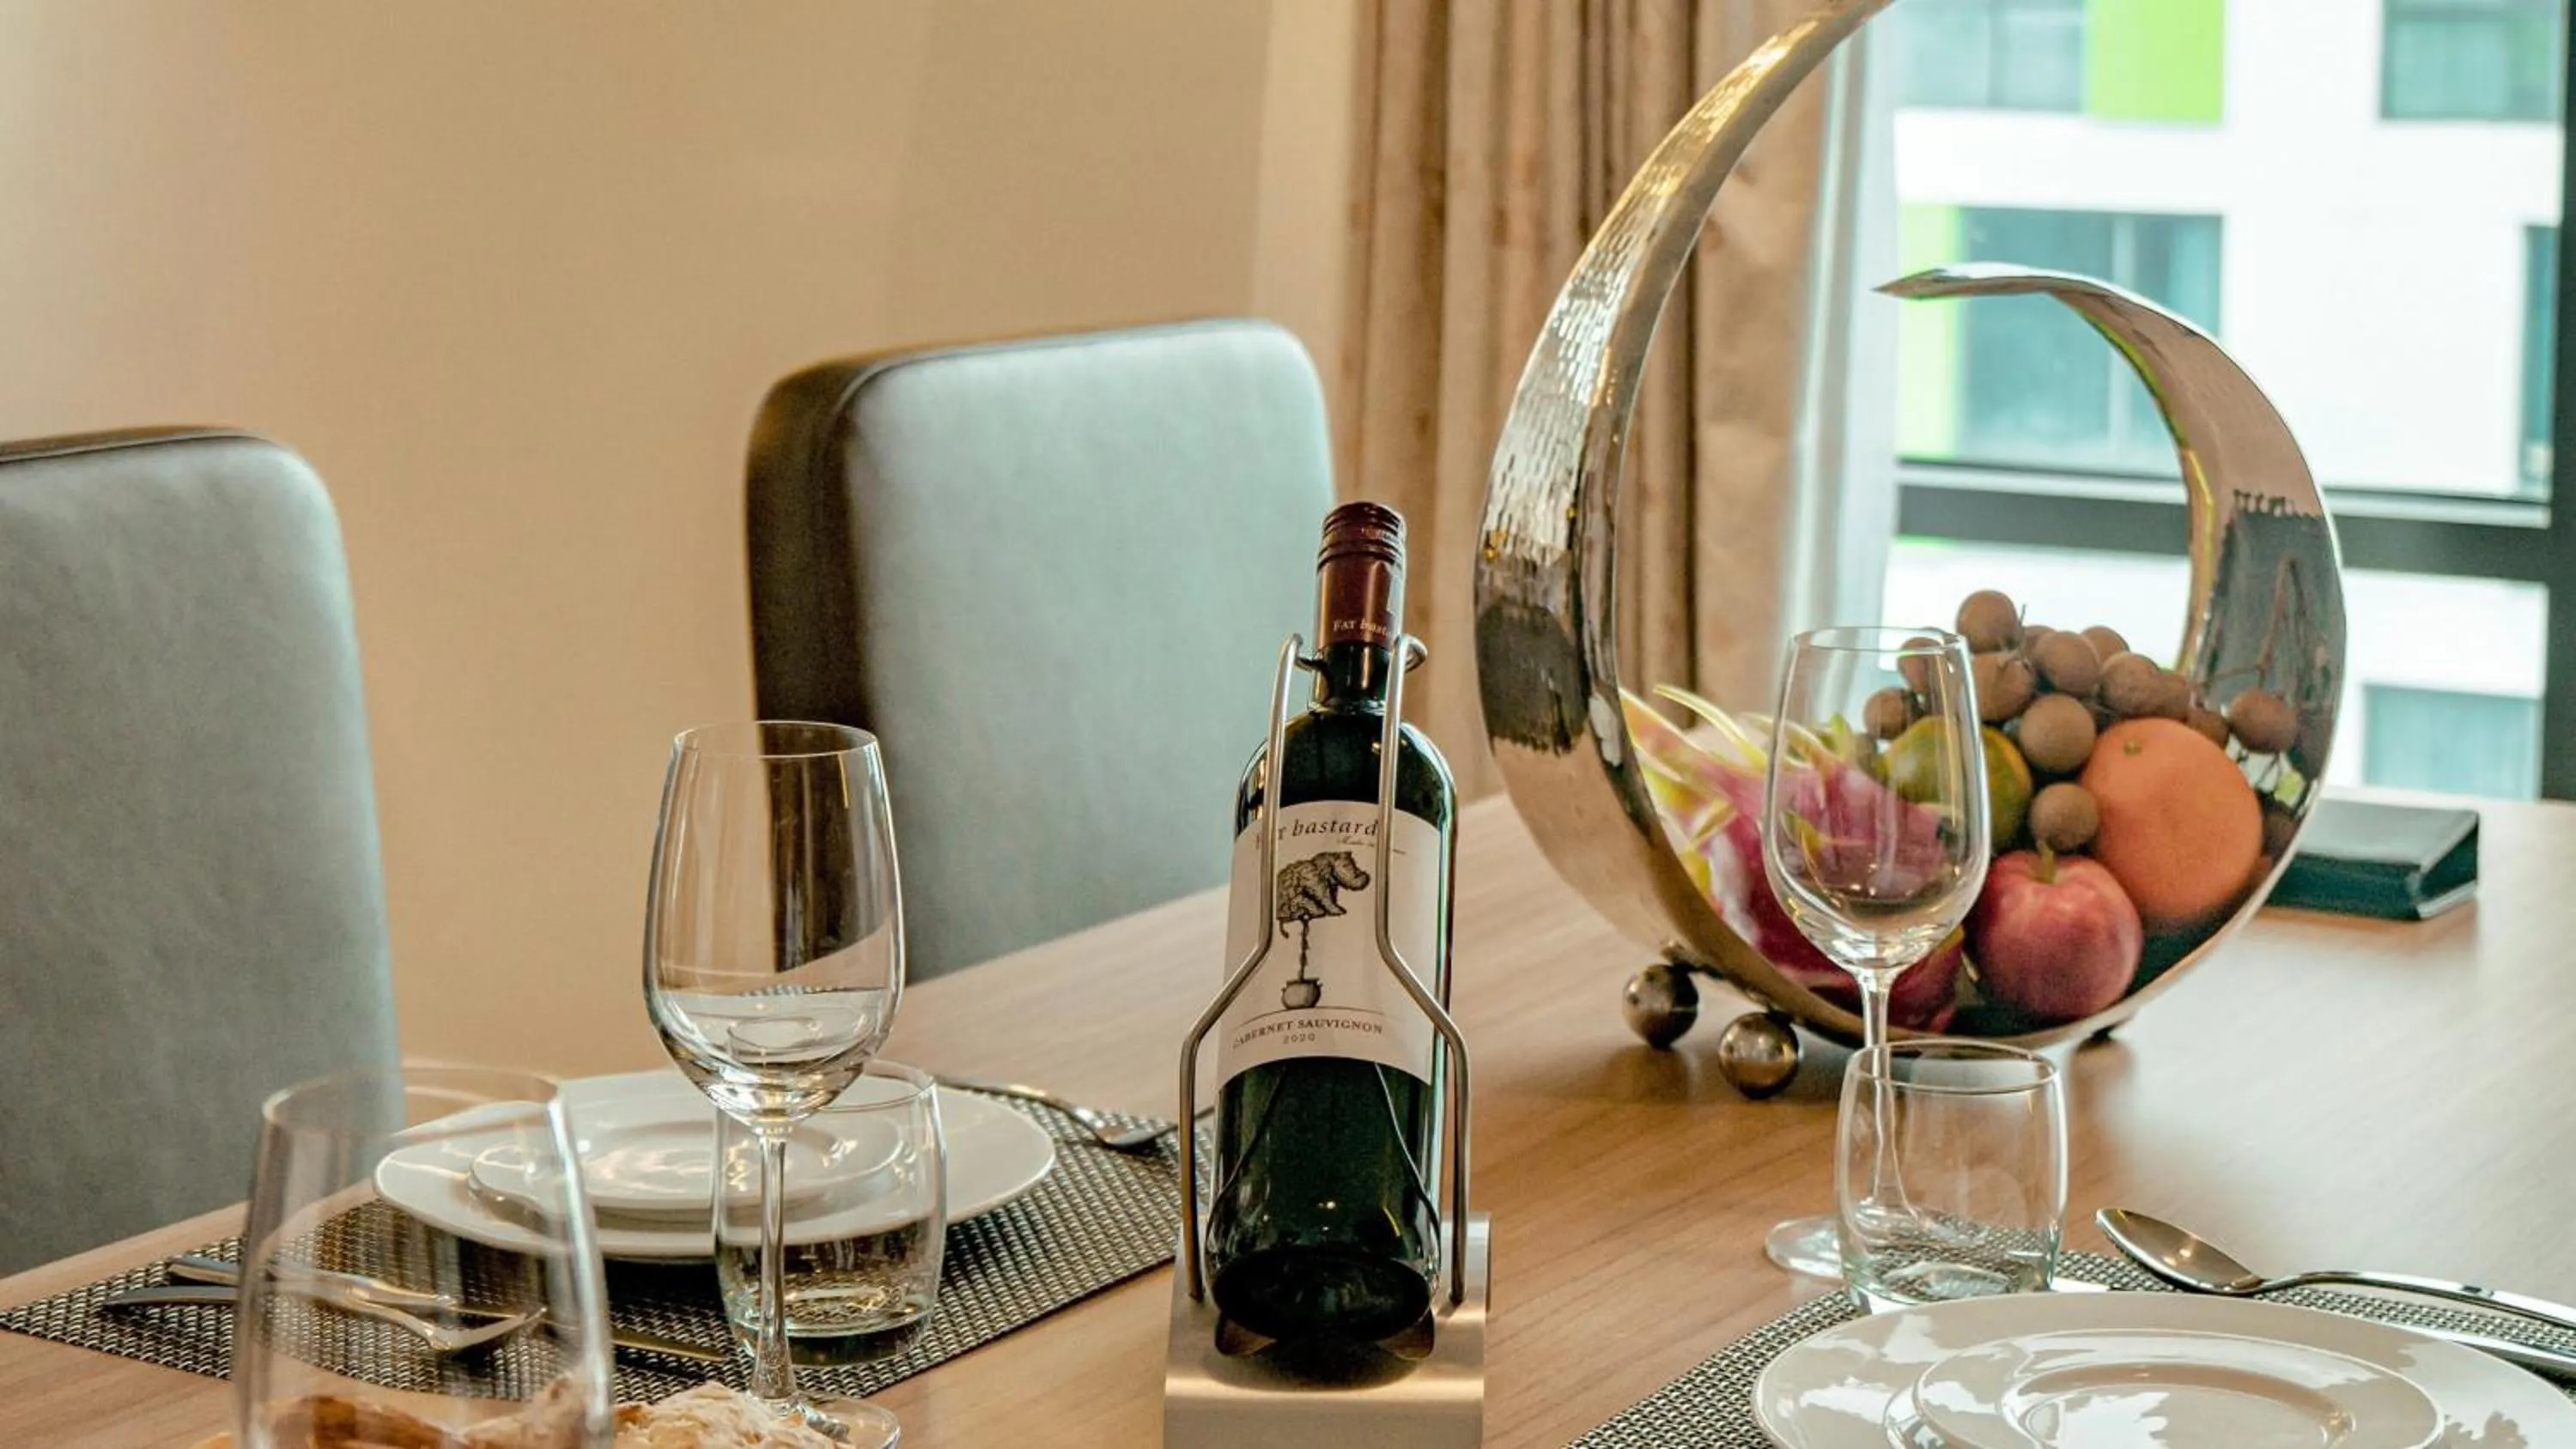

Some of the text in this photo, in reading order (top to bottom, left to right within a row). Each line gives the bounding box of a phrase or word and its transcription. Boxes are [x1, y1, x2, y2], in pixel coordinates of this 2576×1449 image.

[1333, 619, 1357, 632] FAT
[1292, 818, 1378, 837] bastard
[1232, 1019, 1383, 1049] CABERNET SAUVIGNON
